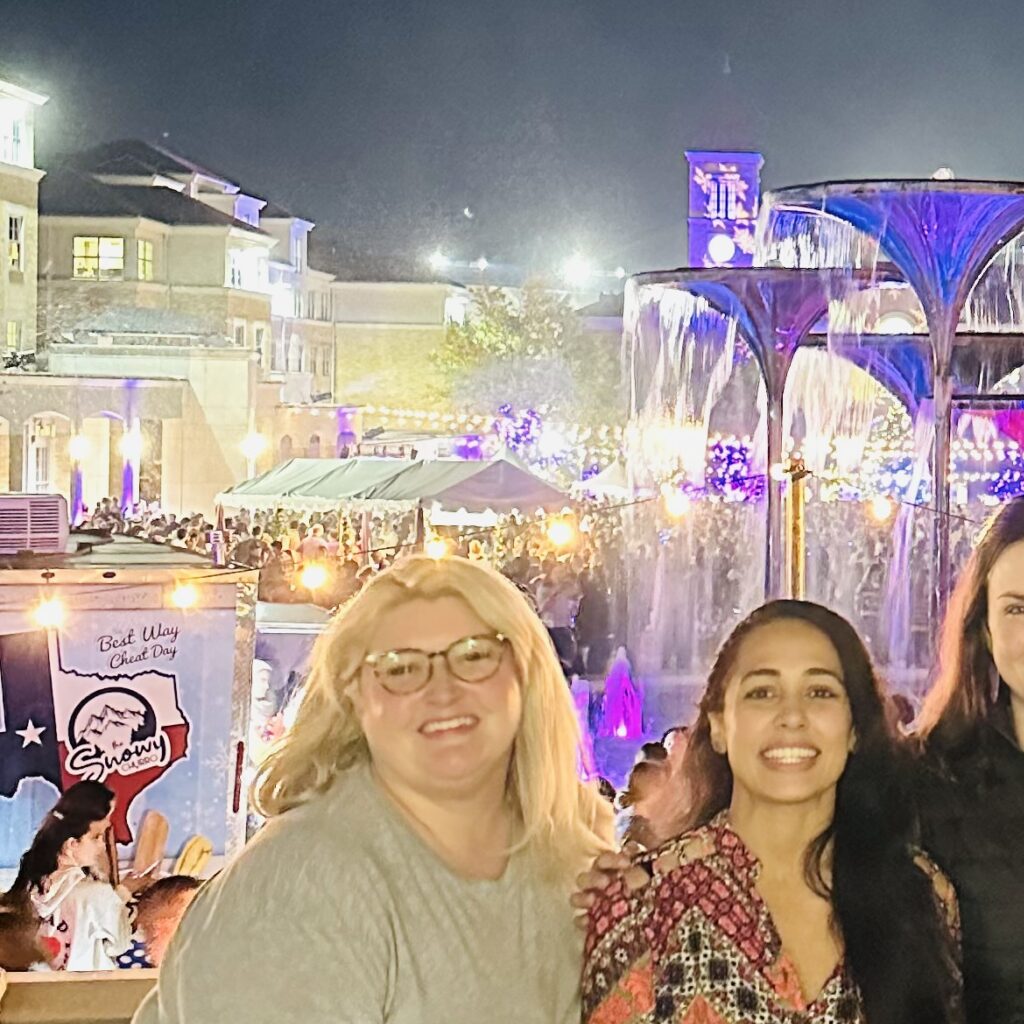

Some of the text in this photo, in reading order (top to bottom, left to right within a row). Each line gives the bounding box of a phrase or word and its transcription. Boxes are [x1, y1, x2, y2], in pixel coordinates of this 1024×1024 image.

[97, 623, 180, 652] Best Way
[110, 644, 178, 669] Cheat Day
[69, 734, 167, 781] Snowy
